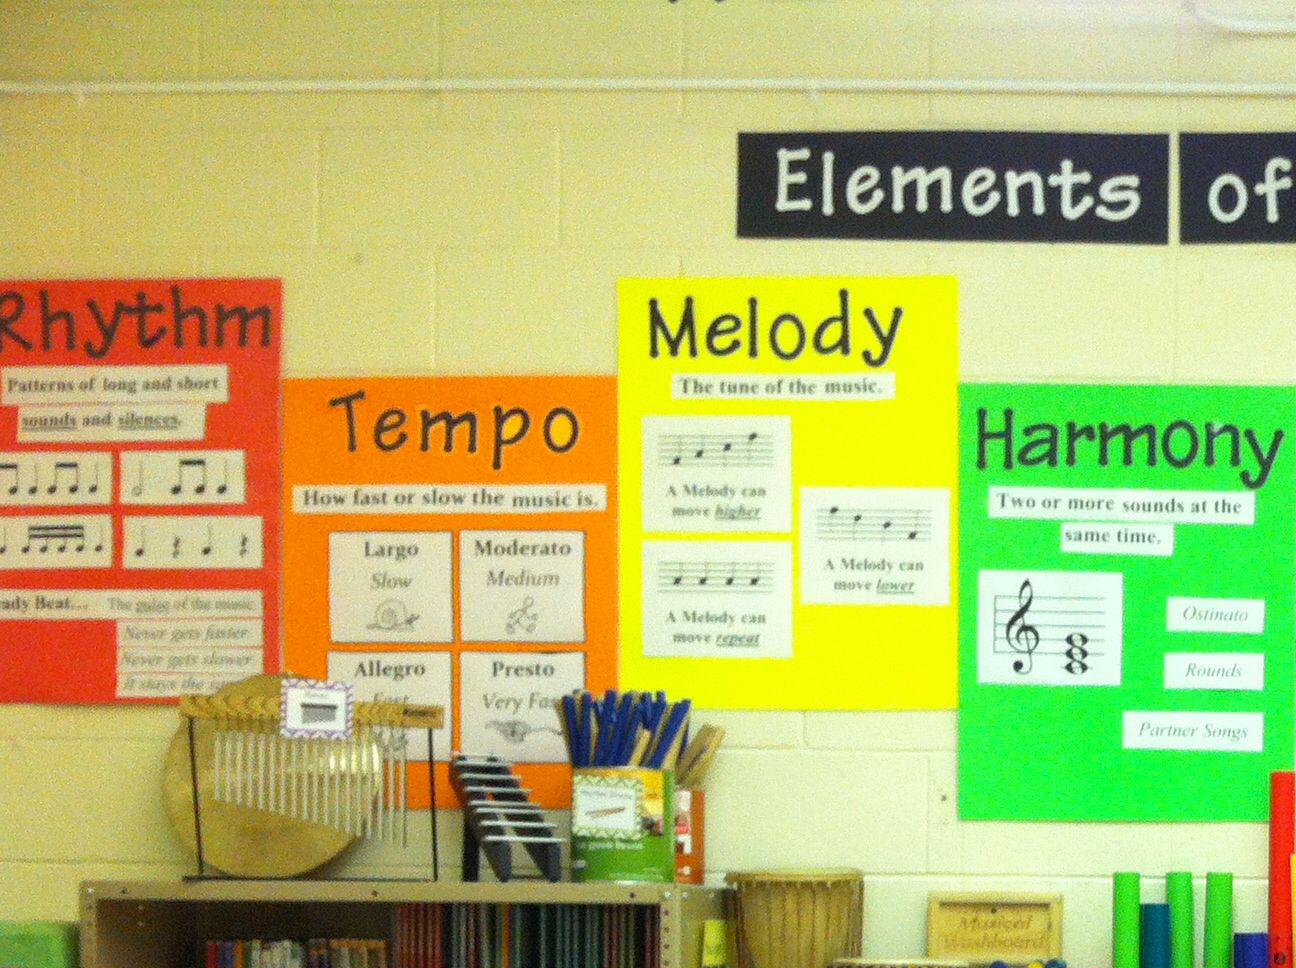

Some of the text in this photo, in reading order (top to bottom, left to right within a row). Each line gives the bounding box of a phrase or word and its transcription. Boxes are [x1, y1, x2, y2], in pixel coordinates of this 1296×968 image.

[776, 147, 1141, 221] Elements
[1208, 157, 1293, 223] of
[0, 285, 271, 359] Rhythm
[649, 289, 903, 367] Melody
[8, 376, 218, 394] Patterns of long and short
[681, 378, 882, 395] The tune of the music.
[22, 411, 181, 431] sounds and silences.
[328, 390, 579, 470] Tempo
[976, 407, 1284, 489] Harmony
[303, 488, 598, 508] How fast or slow the music is.
[666, 484, 766, 500] A Melody can
[672, 504, 761, 521] move higher
[999, 493, 1242, 515] Two or more sounds at the
[1064, 529, 1161, 544] same time.
[364, 541, 419, 560] Largo
[474, 540, 571, 558] Moderato
[824, 558, 924, 574] A Melody can
[370, 573, 412, 590] Slow
[487, 570, 559, 587] Medium
[834, 578, 915, 594] move lower
[666, 611, 766, 627] A Melody can
[1183, 606, 1249, 622] Ostinato
[673, 631, 760, 647] move repeat
[355, 660, 426, 680] Allegro
[492, 661, 555, 678] Presto
[1185, 662, 1243, 678] Rounds
[483, 693, 523, 711] Very
[1139, 722, 1247, 741] Partner Songs
